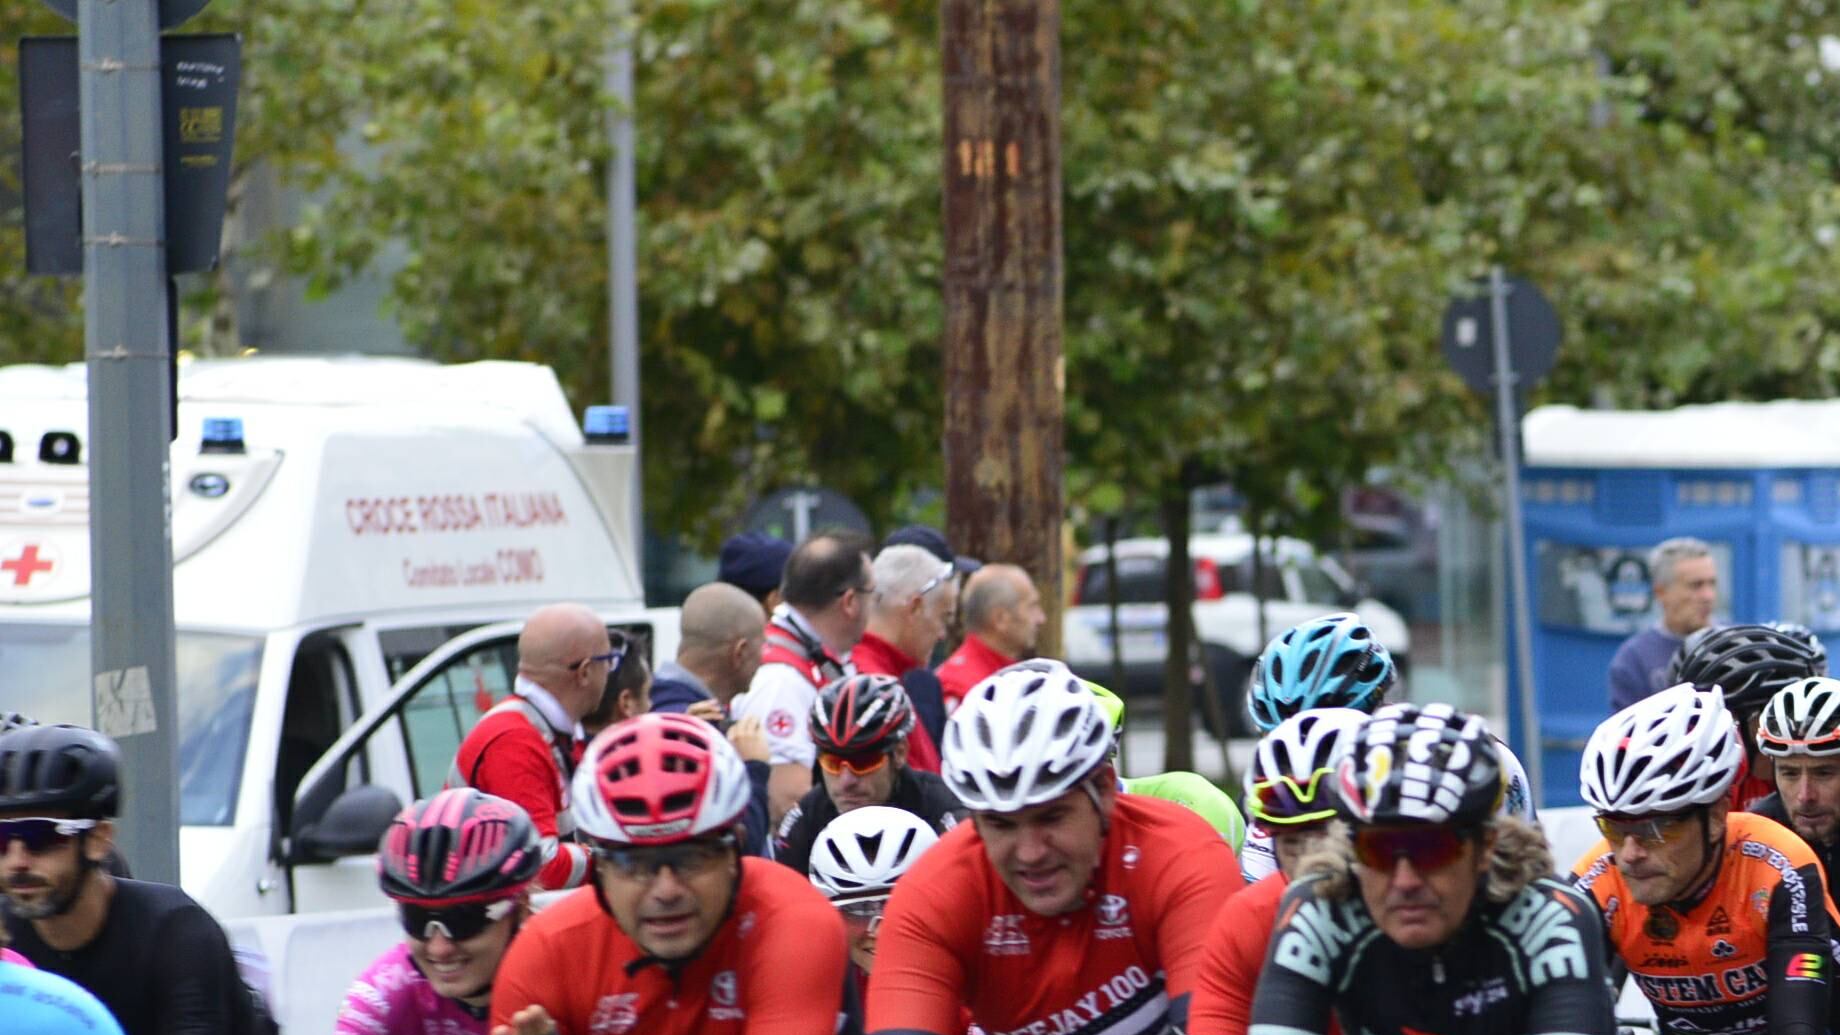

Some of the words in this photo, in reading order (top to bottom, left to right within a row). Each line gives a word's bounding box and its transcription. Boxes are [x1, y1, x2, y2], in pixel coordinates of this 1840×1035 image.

[345, 497, 418, 534] CROCE
[417, 495, 483, 531] ROSSA
[483, 491, 569, 528] ITALIANA
[1501, 880, 1590, 986] BIKE
[1100, 965, 1150, 1009] 100
